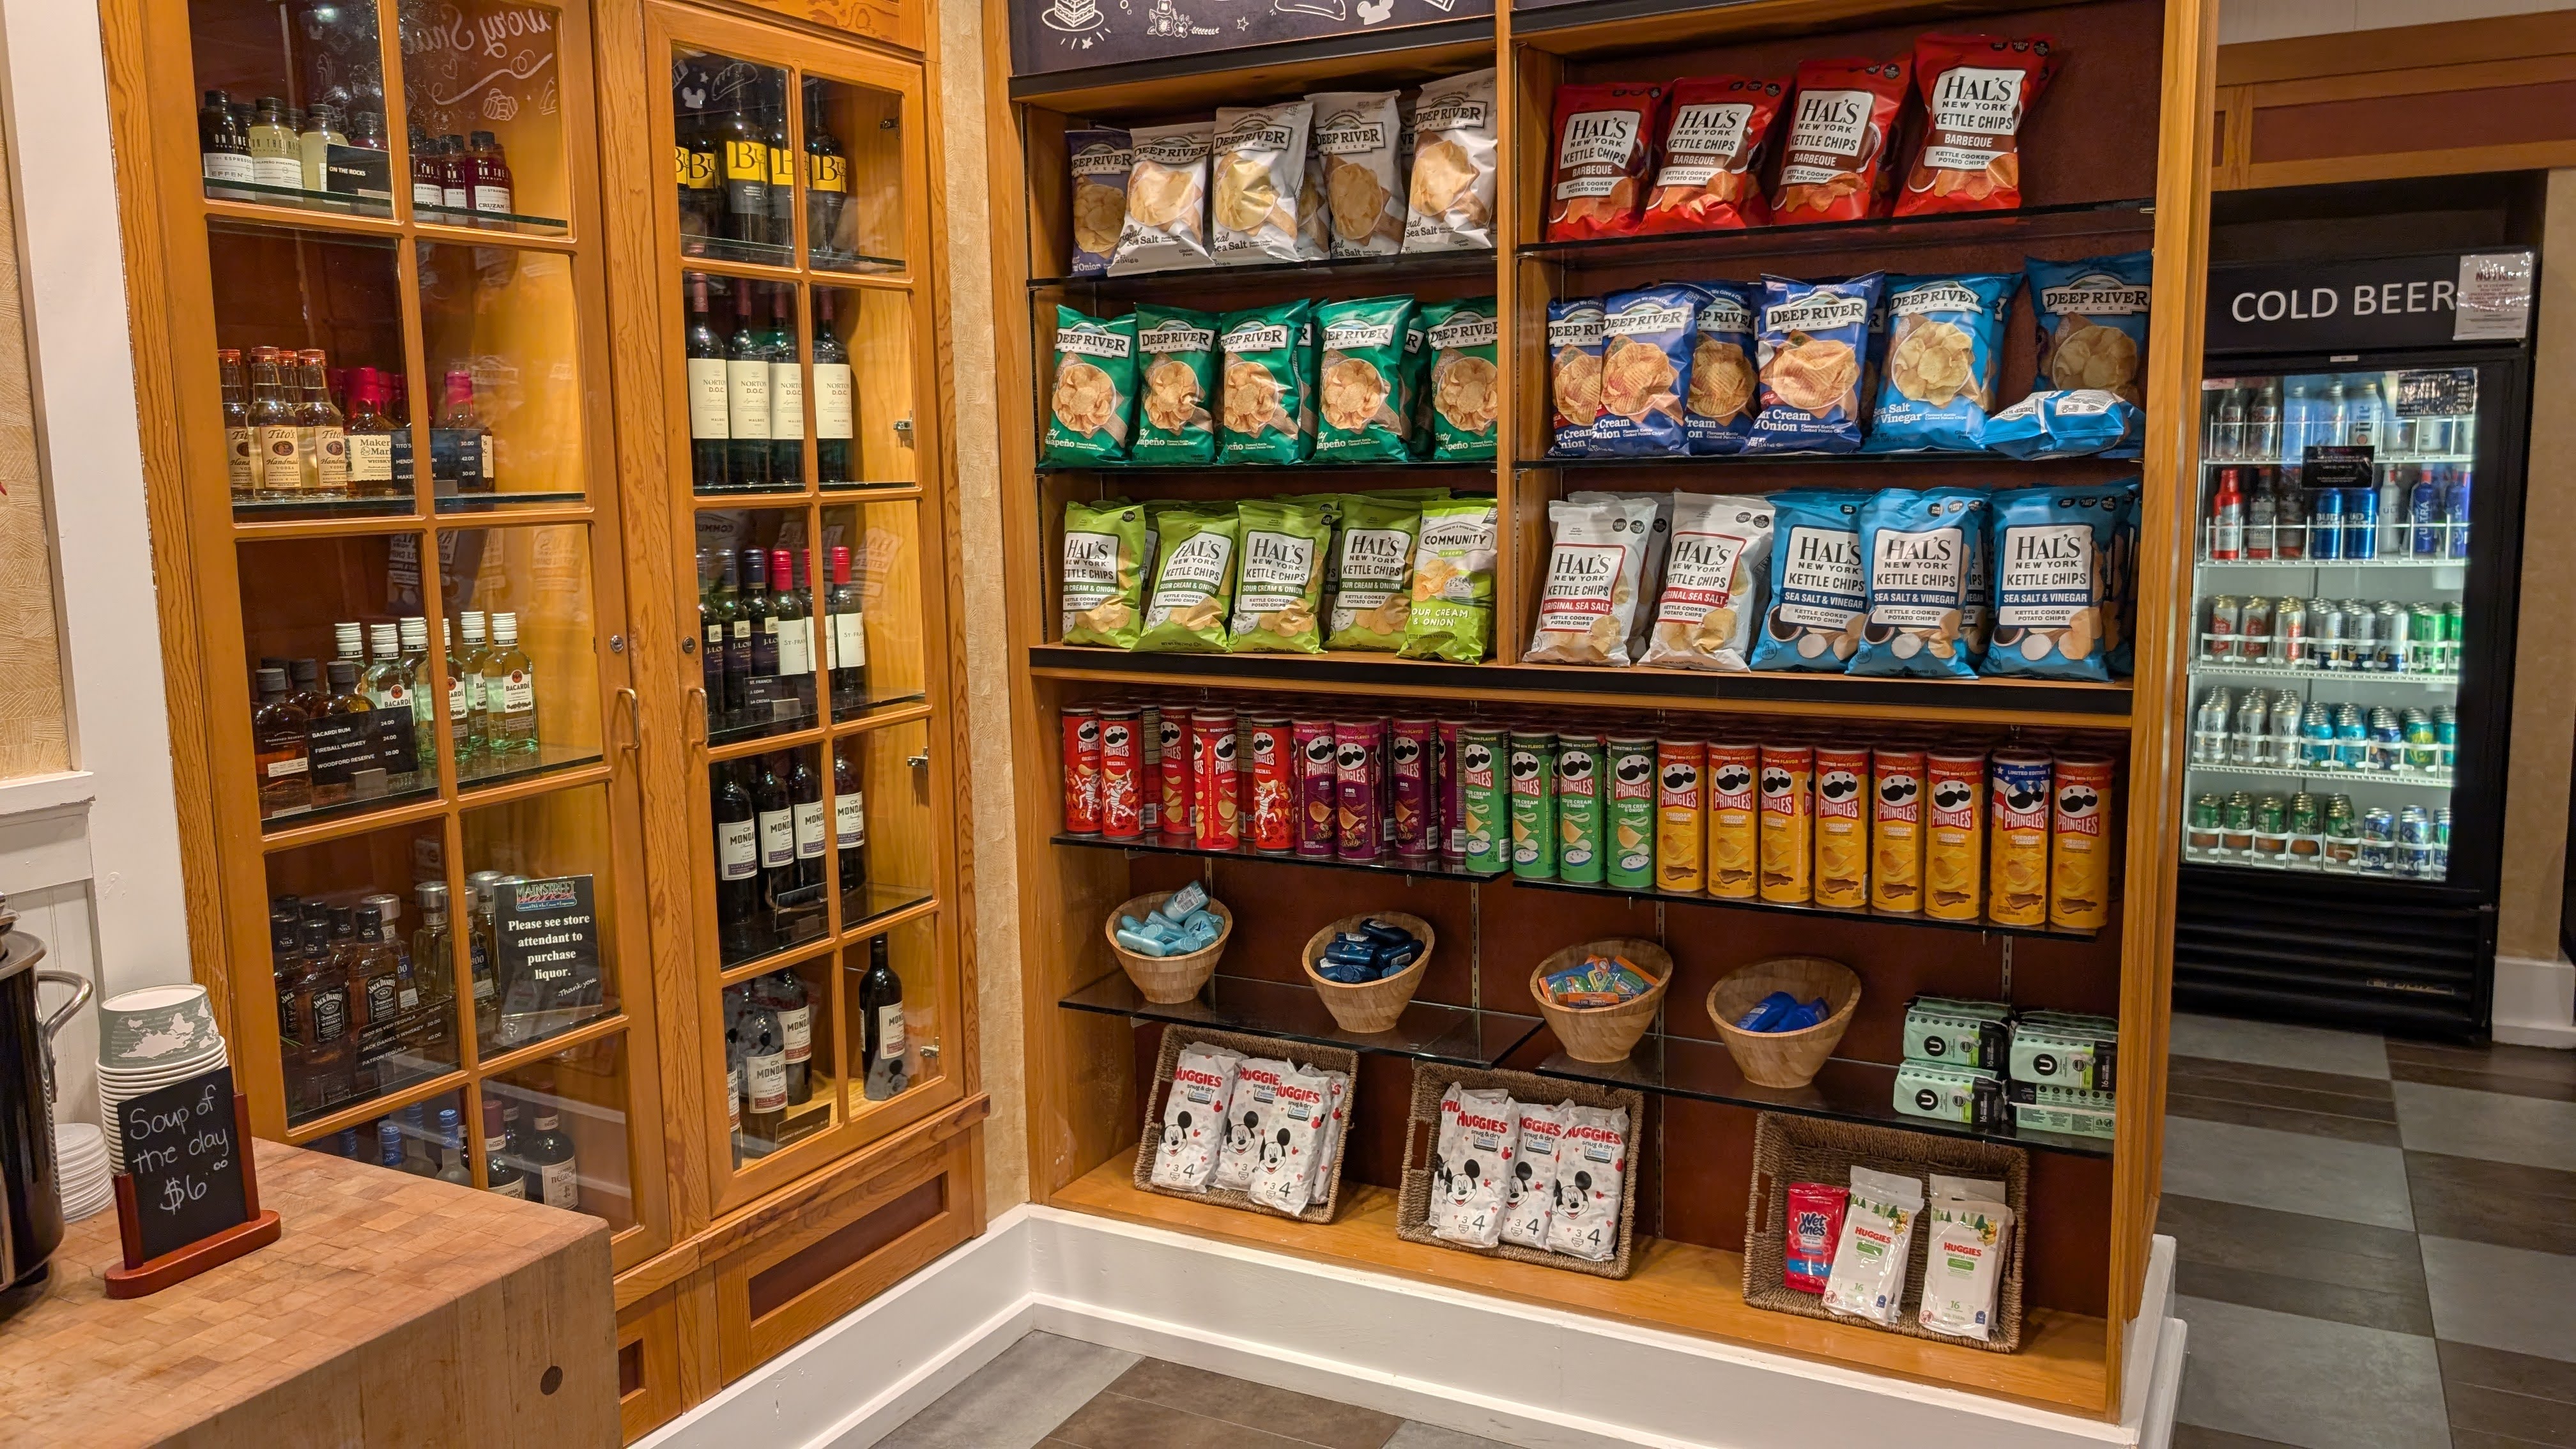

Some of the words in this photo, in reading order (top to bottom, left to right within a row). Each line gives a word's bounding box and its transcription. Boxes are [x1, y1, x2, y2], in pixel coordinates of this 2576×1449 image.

[1943, 75, 2012, 102] HAL'S
[1441, 107, 1481, 121] RIVER
[1972, 103, 2005, 111] YORK
[1681, 109, 1740, 129] HAL'S
[1935, 114, 1974, 126] KETTLE
[1978, 116, 2012, 130] CHIPS
[1945, 134, 1993, 148] BARBEQUE
[1673, 155, 1715, 165] BARBEQUE
[1793, 153, 1836, 167] BARBEQUE
[1572, 166, 1613, 177] BARBEQUE
[1420, 225, 1438, 236] Salt
[2046, 292, 2089, 307] DEEP
[2092, 291, 2147, 305] RIVER
[2232, 288, 2338, 323] COLD
[2354, 281, 2455, 316] BEER
[1770, 309, 1809, 325] DEEP
[1811, 302, 1864, 319] RIVER
[1081, 333, 1126, 352] RIVER
[1142, 334, 1167, 346] DEEP
[1169, 332, 1210, 346] RIVER
[1430, 328, 1460, 343] DEEP
[1889, 402, 1910, 413] Salt
[1772, 410, 1811, 421] Cream
[1880, 413, 1922, 424] Vinegar
[1762, 422, 1798, 431] Onion
[1350, 535, 1400, 557] HAL'S
[1425, 534, 1487, 546] COMMUNITY
[2016, 533, 2081, 560] HAL'S
[1254, 538, 1304, 565] HAL'S
[1674, 540, 1731, 567] HAL'S
[1798, 536, 1861, 566] HAL'S
[1885, 537, 1951, 561] HAL'S
[1343, 565, 1372, 575] KETTLE
[1374, 565, 1401, 576] CHIPS
[1556, 553, 1611, 575] HAL'S
[2047, 560, 2078, 569] YORK
[2007, 574, 2048, 586] KETTLE
[2051, 572, 2087, 585] CHIPS
[1548, 586, 1579, 596] KETTLE
[1582, 586, 1609, 597] CHIPS
[2004, 594, 2019, 603] SEA
[2021, 594, 2039, 603] SALT
[2042, 594, 2048, 602] &
[2050, 594, 2087, 602] VINEGAR
[1436, 609, 1469, 617] CREAM
[1544, 602, 1573, 611] ORIGINAL
[1591, 603, 1609, 612] SALT
[1423, 618, 1455, 627] ONION
[506, 681, 530, 691] BACARDÍ
[312, 728, 338, 739] BACARDI
[315, 744, 341, 753] FIREBALL
[341, 740, 366, 749] WHISKEY
[318, 758, 349, 769] WOODFORD
[1307, 762, 1335, 777] PRINGLES
[1337, 767, 1366, 784] PRINGLES
[1615, 782, 1651, 798] PRINGLES
[1715, 792, 1751, 809] PRINGLES
[838, 805, 862, 816] MONDA
[1932, 808, 1971, 827] PRINGLES
[2004, 811, 2044, 828] PRINGLES
[2057, 815, 2097, 834] PRINGLES
[730, 831, 754, 845] MONDA
[508, 920, 542, 931] Please
[545, 919, 561, 928] see
[564, 915, 590, 925] store
[518, 933, 569, 947] attendant
[572, 931, 583, 942] to
[527, 950, 576, 965] purchase
[535, 968, 571, 981] liquor.
[129, 1107, 189, 1140] Soup
[195, 1083, 216, 1115] of
[1457, 1112, 1508, 1133] HUGGIES
[133, 1146, 178, 1174] the
[188, 1128, 230, 1158] day
[1183, 1163, 1195, 1179] 4
[1801, 1213, 1827, 1226] Wet
[1588, 1229, 1600, 1246] 4
[1798, 1224, 1826, 1236] Ones
[1855, 1226, 1891, 1244] HUGGIES
[1943, 1242, 1981, 1257] HUGGIES
[1950, 1300, 1959, 1309] 16
